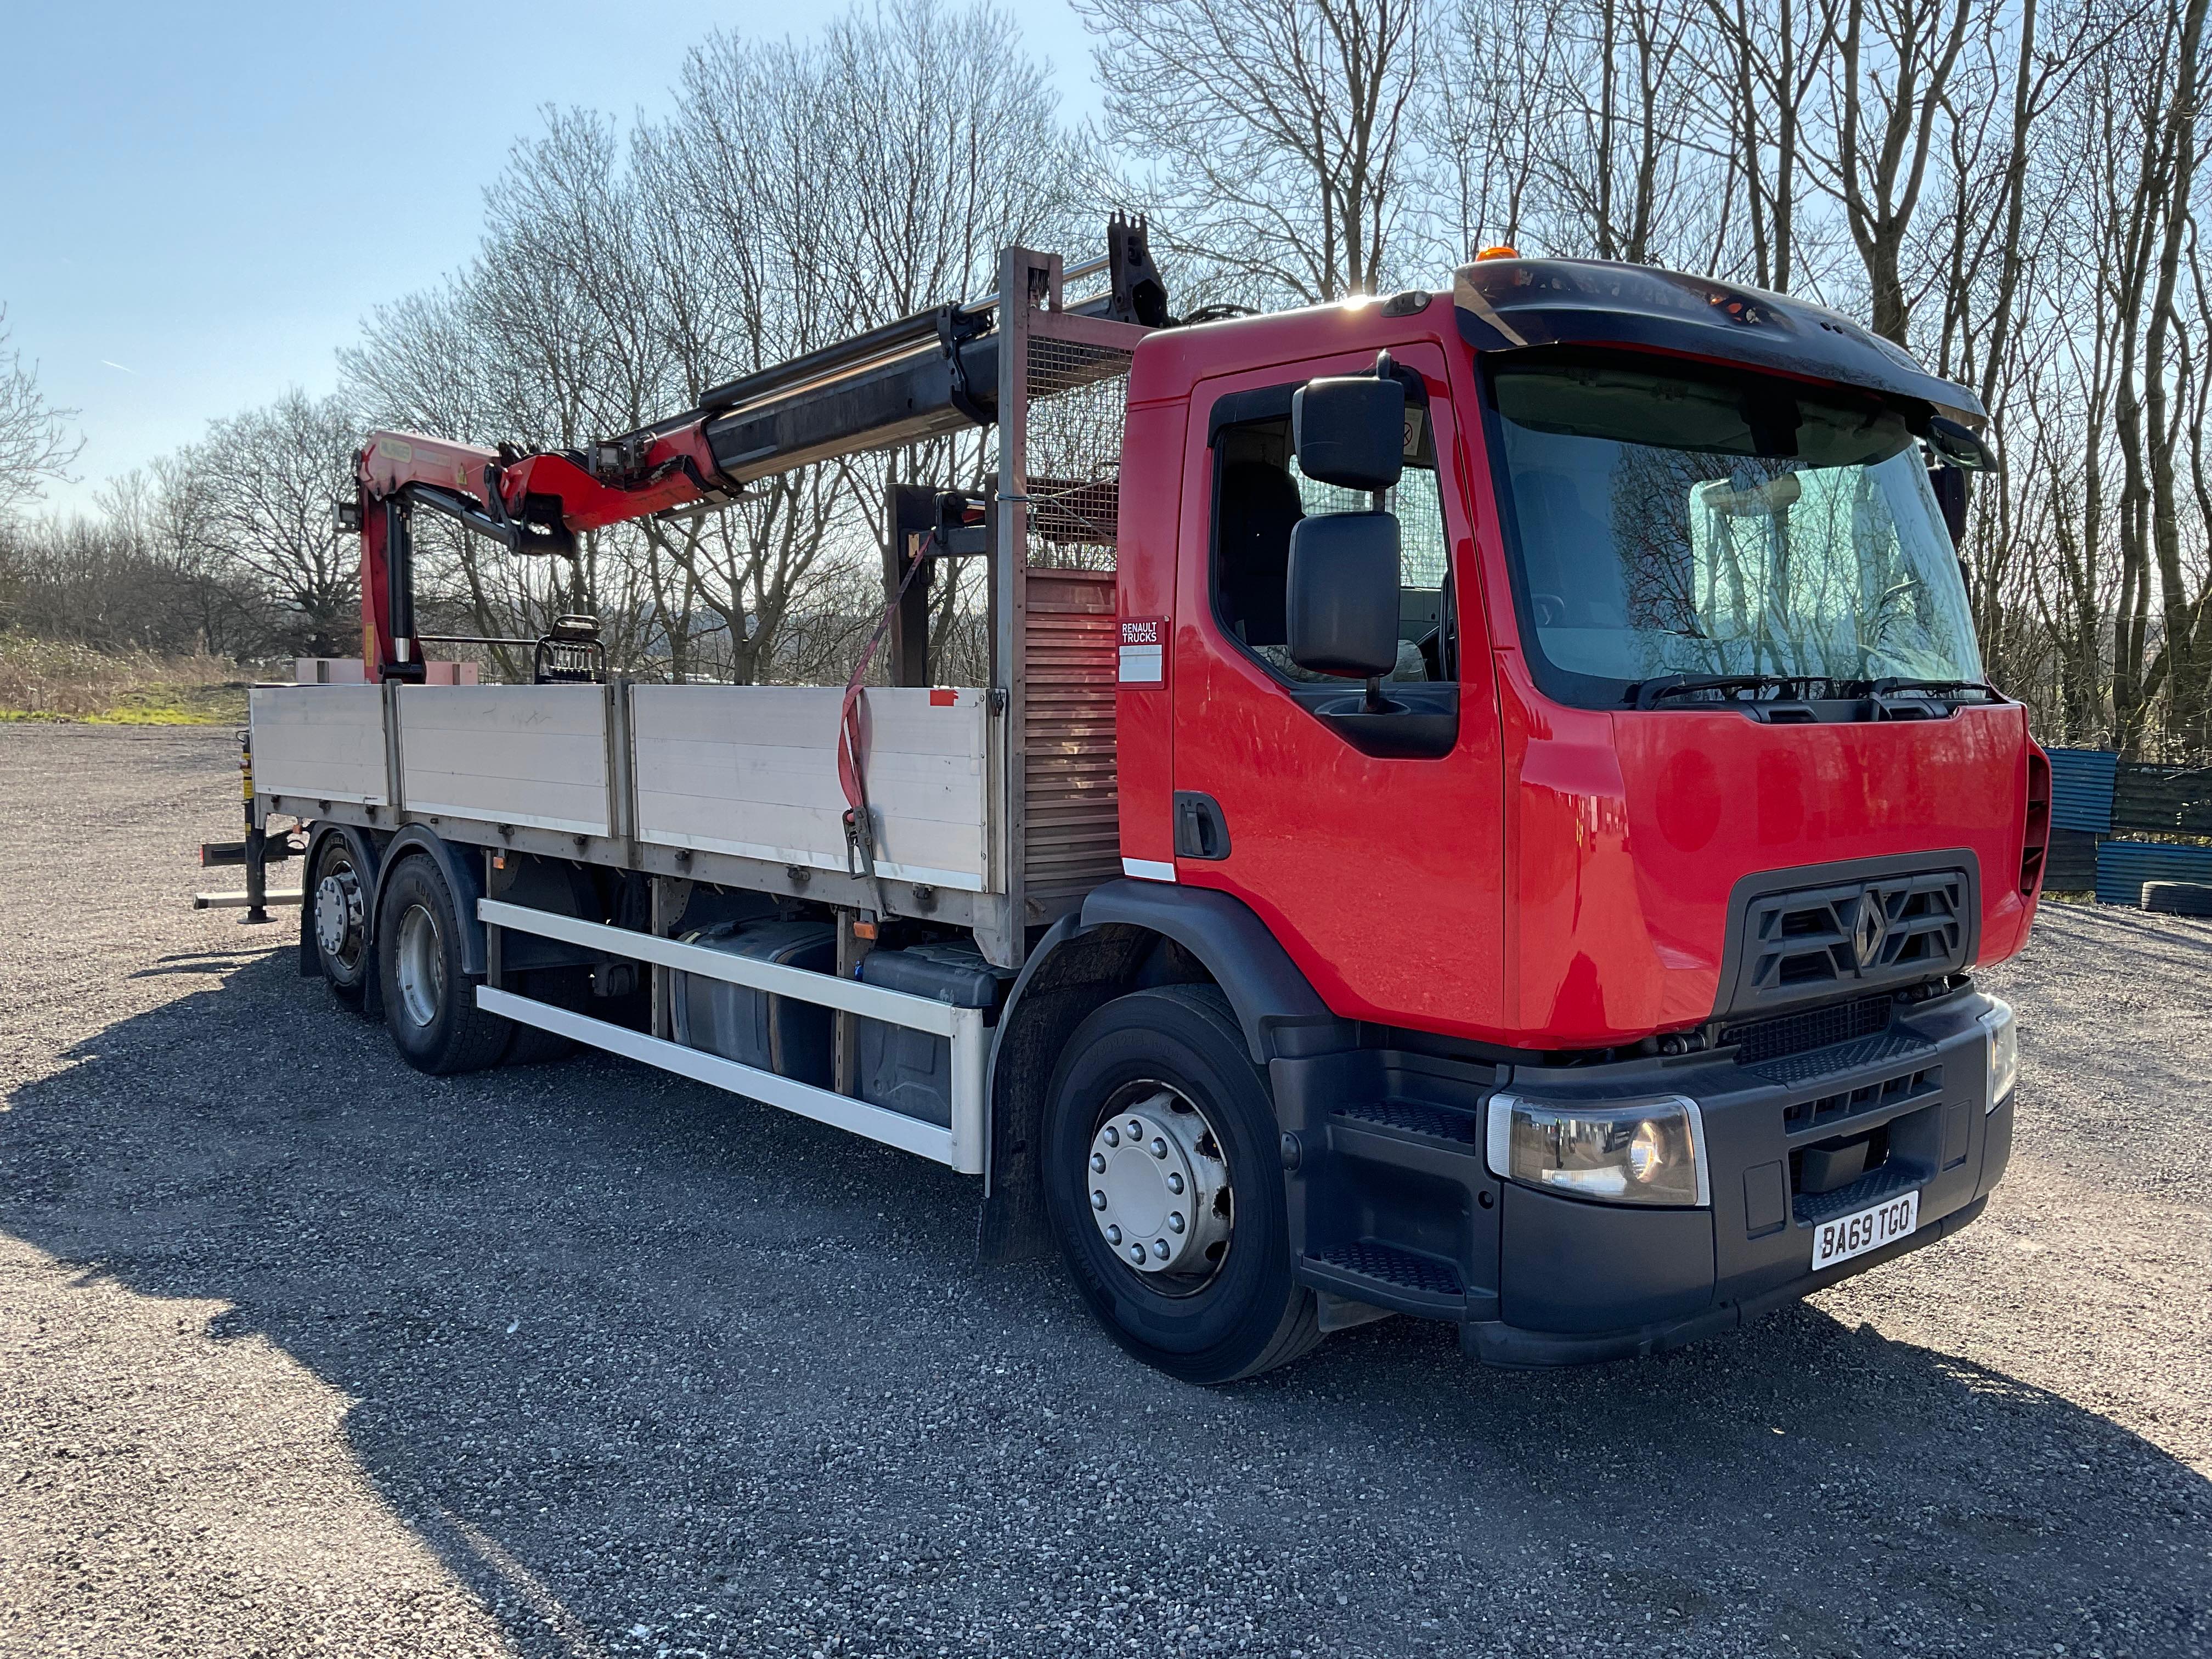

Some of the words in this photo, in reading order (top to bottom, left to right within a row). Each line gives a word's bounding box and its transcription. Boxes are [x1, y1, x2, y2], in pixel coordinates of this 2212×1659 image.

[1122, 622, 1157, 634] RENAULT
[1122, 633, 1157, 643] TRUCKS
[1821, 1214, 1873, 1260] BA69
[1879, 1199, 1910, 1239] TGO
